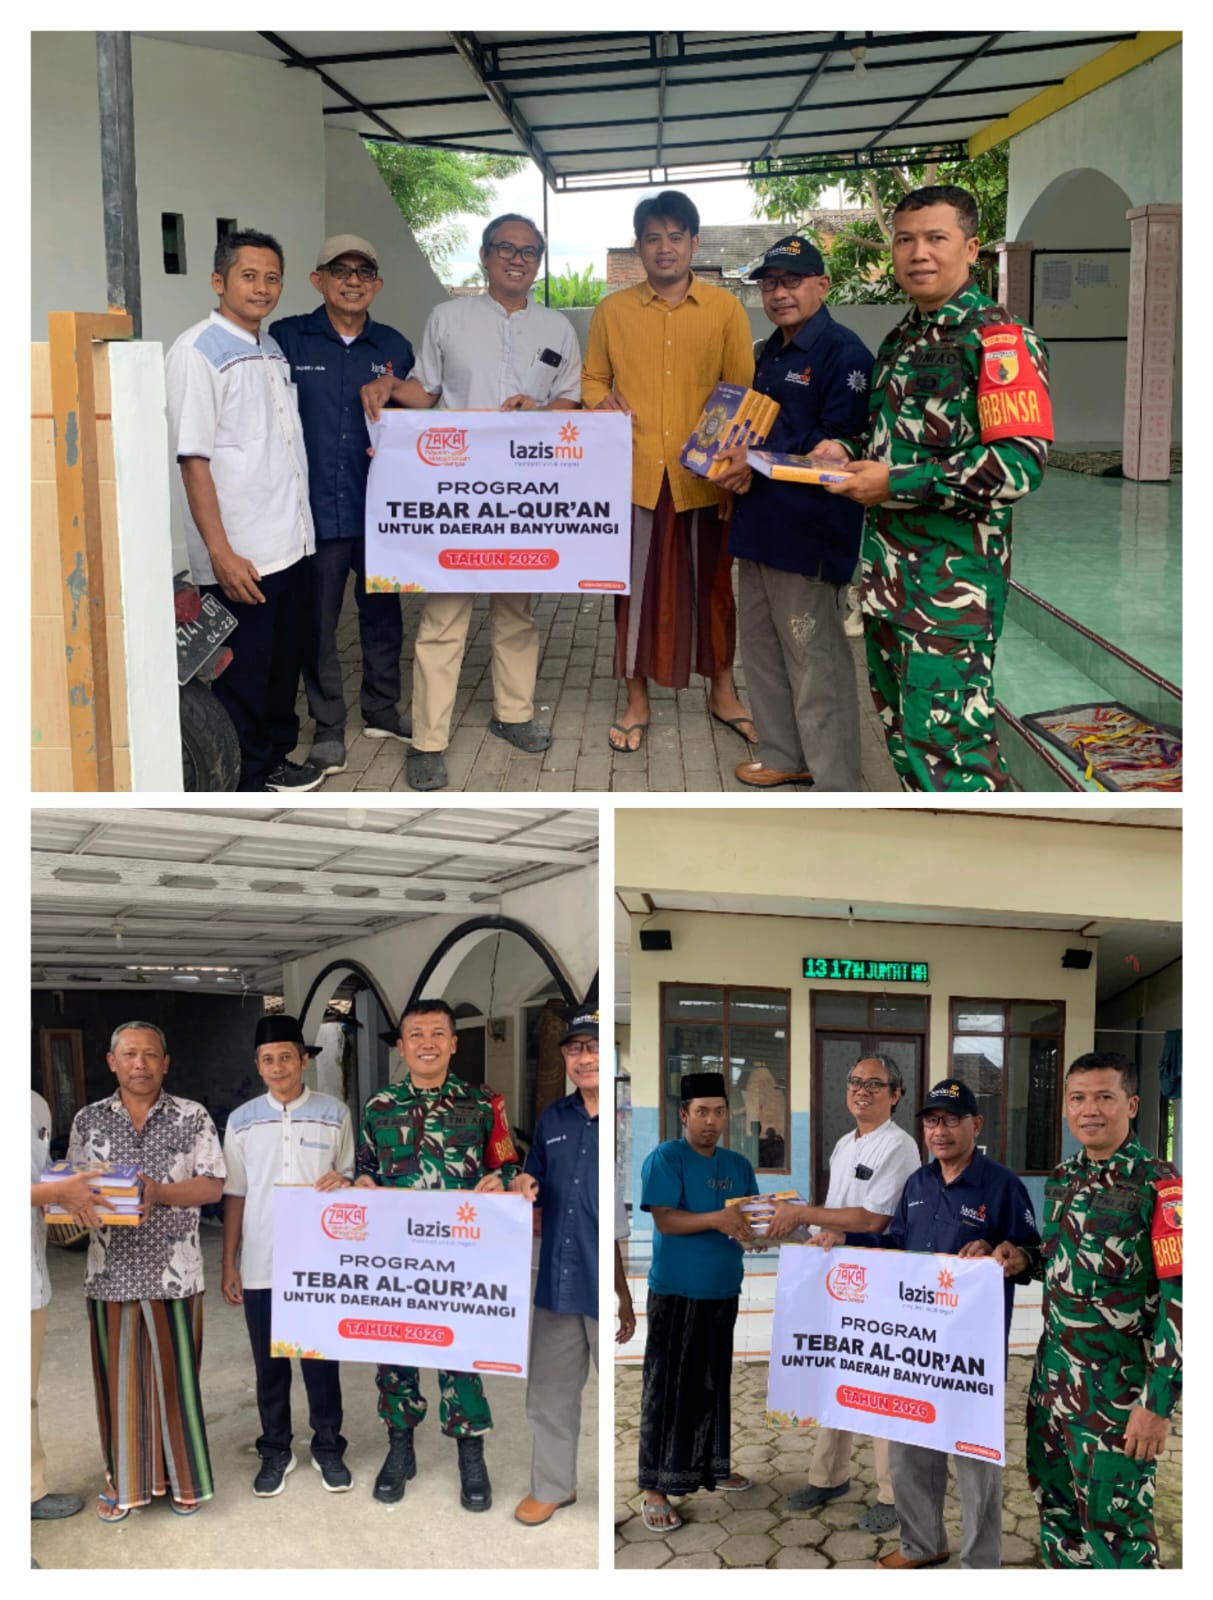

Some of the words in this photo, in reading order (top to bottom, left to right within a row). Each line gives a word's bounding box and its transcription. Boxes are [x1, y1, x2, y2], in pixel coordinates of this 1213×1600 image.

[425, 430, 469, 450] ZAKAT
[510, 440, 584, 460] lazismu
[437, 481, 560, 495] PROGRAM
[386, 501, 470, 519] TEBAR
[478, 501, 611, 519] AL-QUR'AN
[378, 523, 435, 535] UNTUK
[439, 523, 505, 535] DAERAH
[510, 522, 619, 535] BANYUWANGI
[449, 552, 506, 566] TAHUN
[509, 552, 550, 566] 2026
[328, 1206, 369, 1226] ZAKAT
[407, 1218, 481, 1240] lazismu
[340, 1254, 456, 1273] PROGRAM
[292, 1271, 369, 1290] TEBAR
[376, 1275, 508, 1301] AL-QUR'AN
[834, 1266, 868, 1287] ZAKAT
[283, 1291, 336, 1304] UNTUK
[341, 1294, 401, 1308] DAERAH
[406, 1298, 516, 1318] BANYUWANGI
[899, 1281, 959, 1308] lazismu
[346, 1321, 401, 1337] TAHUN
[406, 1327, 446, 1341] 2026
[841, 1316, 937, 1343] PROGRAM
[793, 1333, 865, 1356] TEBAR
[869, 1342, 985, 1376] AL-QUR'AN
[781, 1355, 836, 1368] UNTUK
[840, 1359, 890, 1378] DAERAH
[893, 1368, 994, 1396] BANYUWANGI
[843, 1389, 889, 1411] TAHUN
[892, 1401, 928, 1418] 2026
